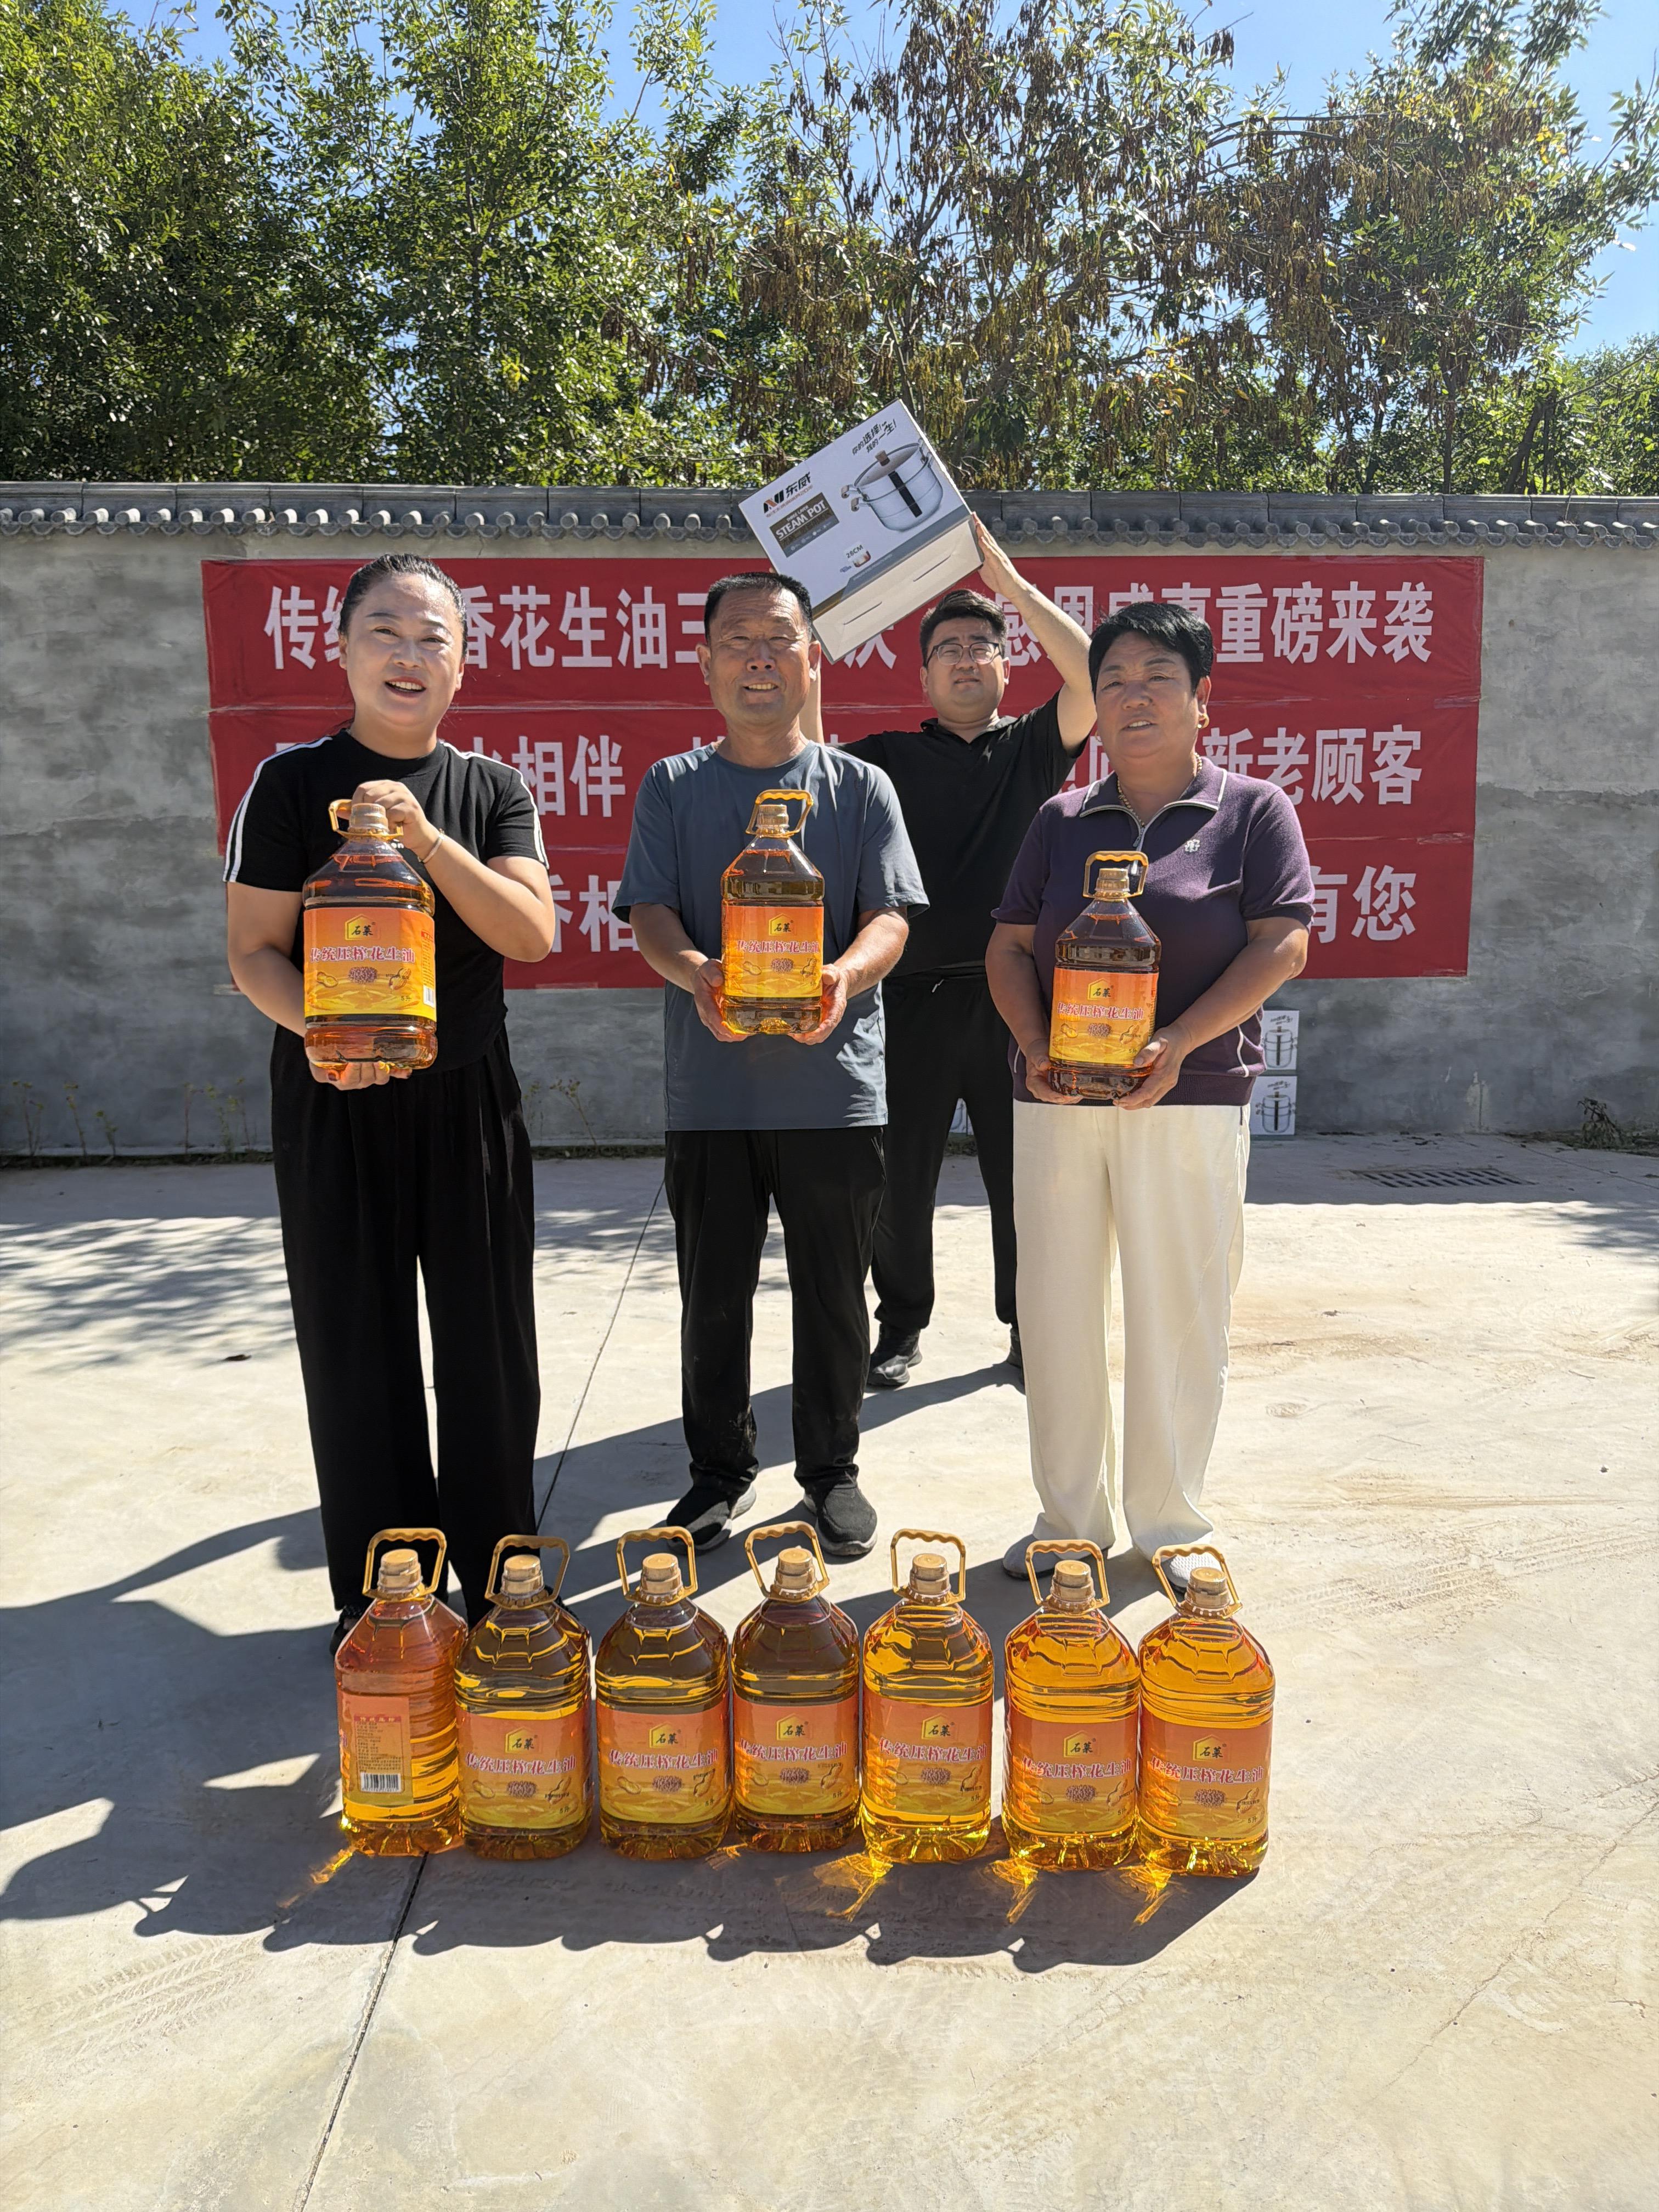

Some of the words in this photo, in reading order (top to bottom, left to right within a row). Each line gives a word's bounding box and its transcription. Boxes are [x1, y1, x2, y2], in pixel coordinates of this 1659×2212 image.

[786, 471, 811, 499] 东威
[775, 514, 808, 539] STEAM
[807, 499, 827, 517] POT
[845, 544, 864, 558] 28CM
[310, 946, 415, 963] 传统压榨花生油
[736, 940, 819, 955] 传统压榨花生油
[1058, 1001, 1144, 1020] 传统压榨花生油
[609, 1747, 718, 1770] 传统压榨花生油
[740, 1737, 847, 1762] 传统压榨花生油
[878, 1737, 987, 1763] 传统压榨花生油
[465, 1752, 576, 1776] 传统压榨花生油
[1022, 1756, 1131, 1779] 传统压榨花生油
[1152, 1756, 1263, 1784] 传统压榨花生油
